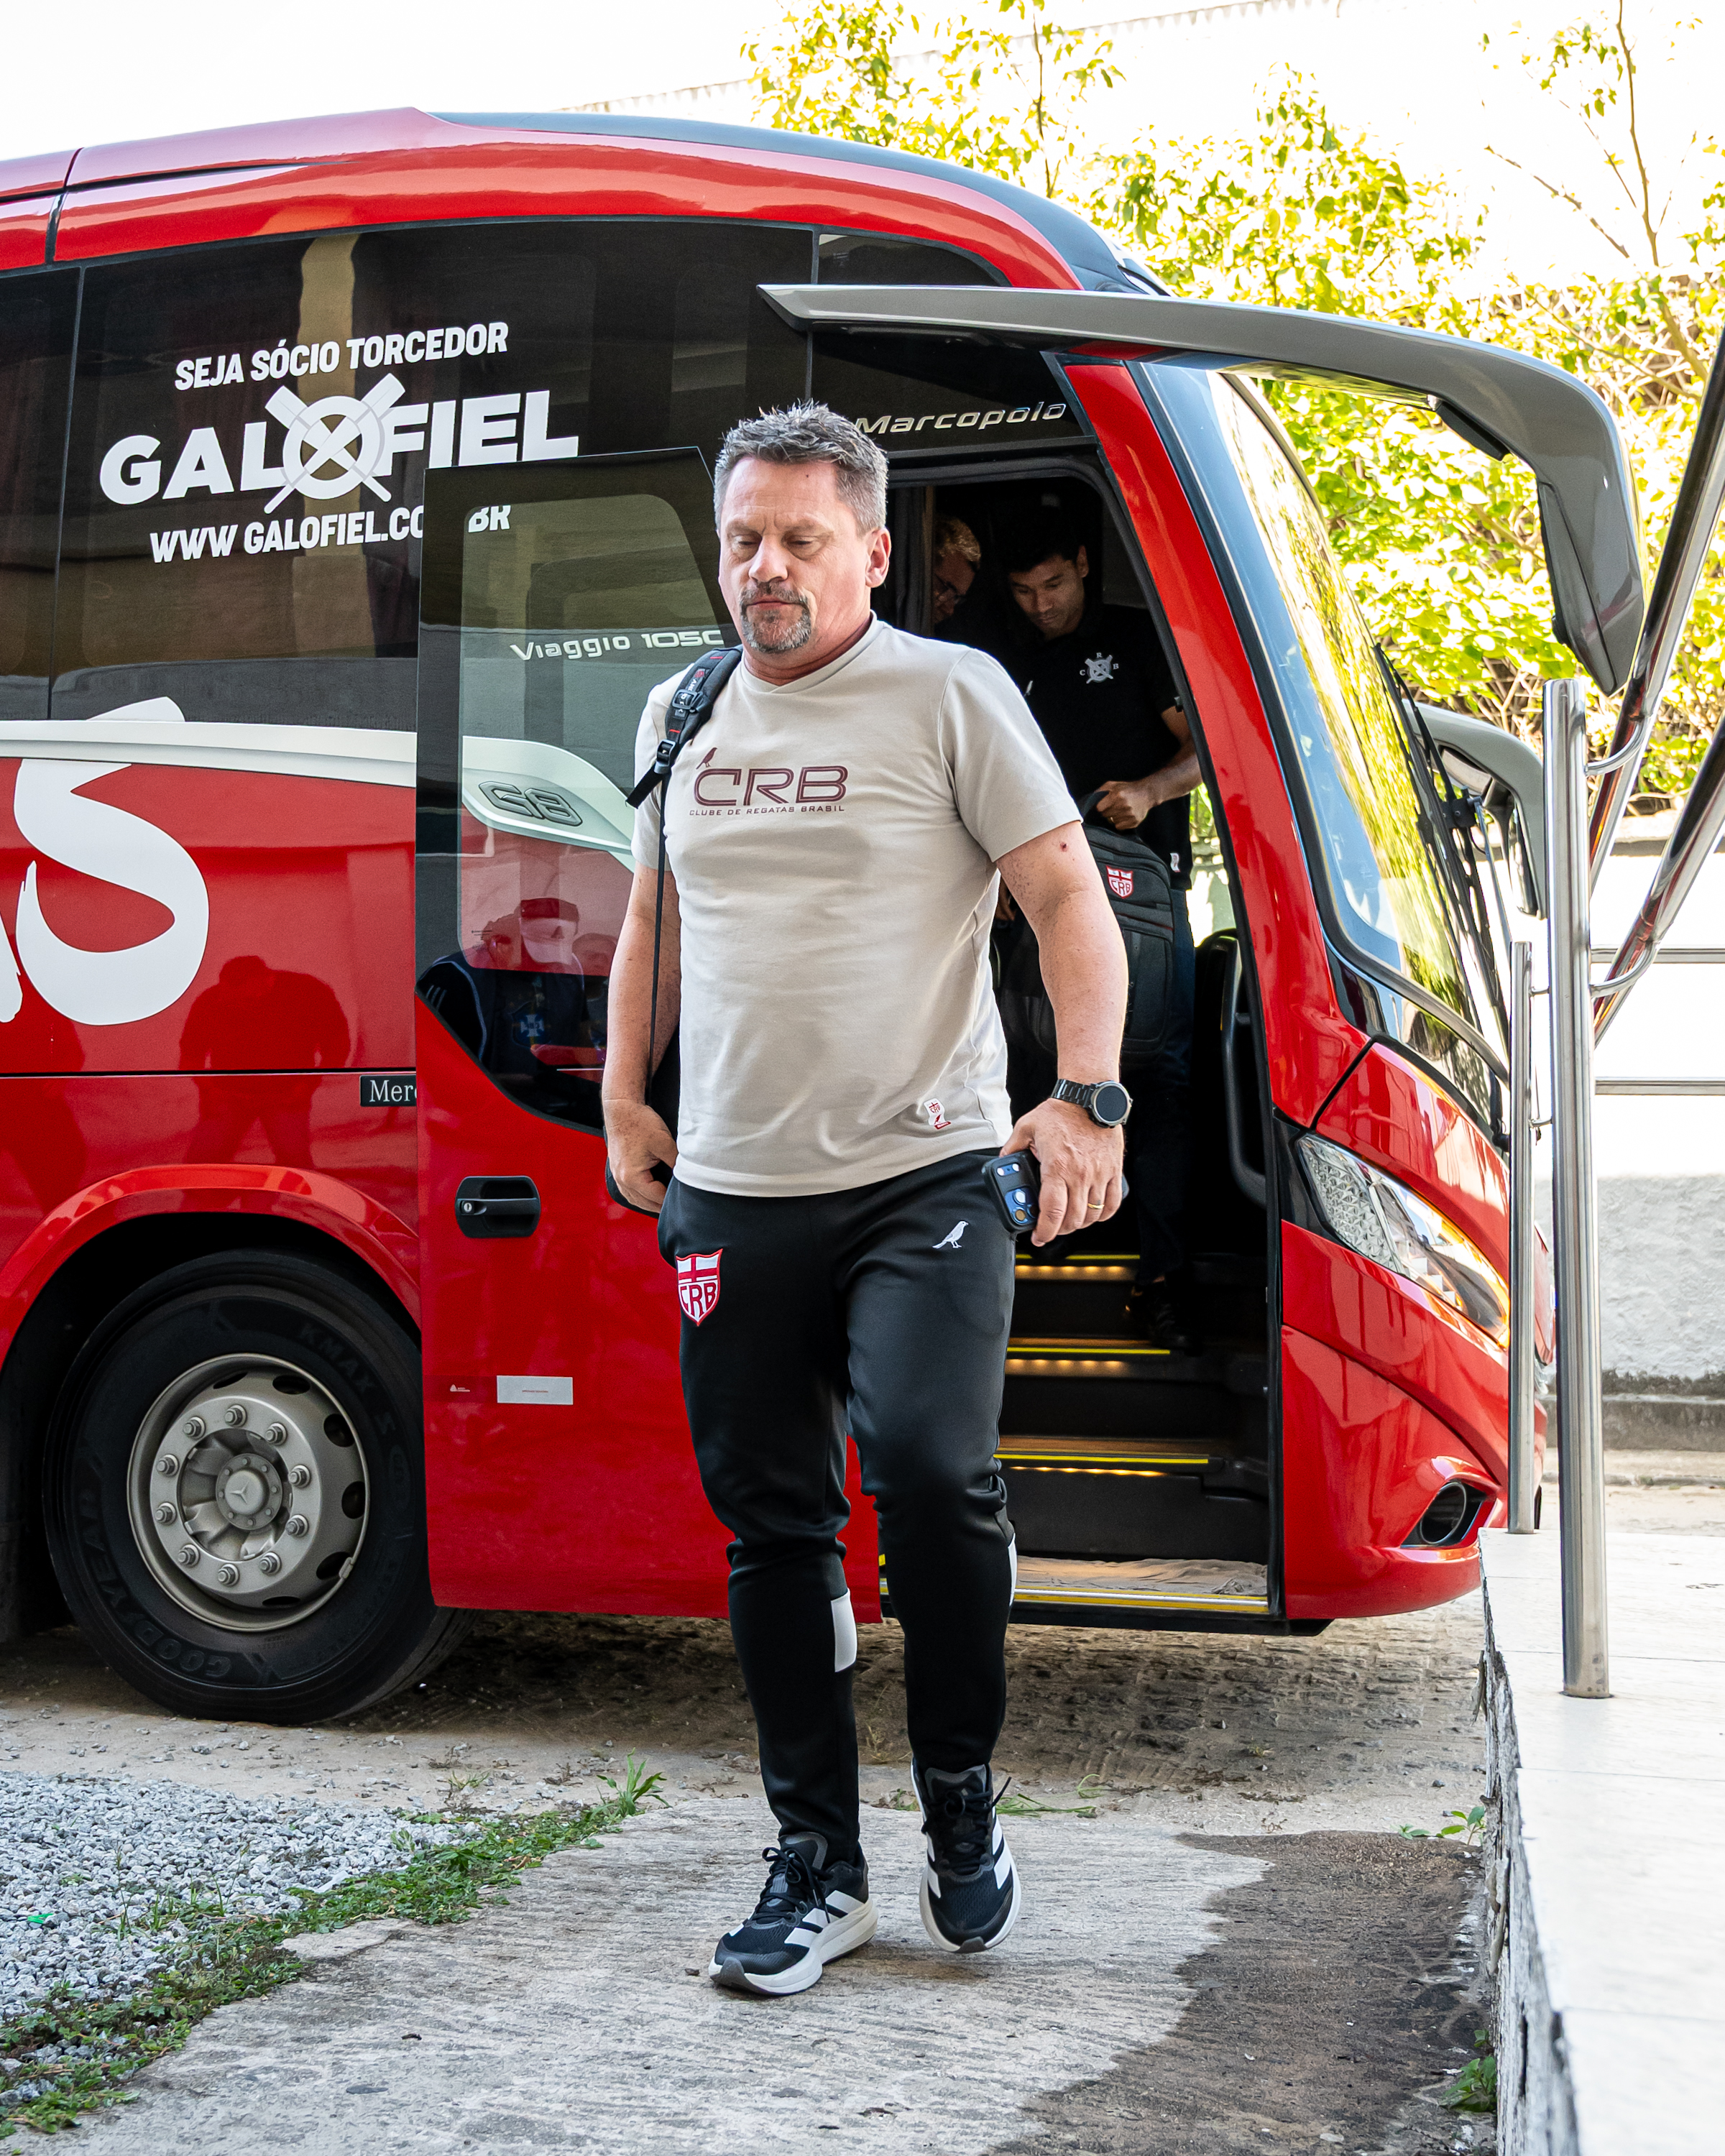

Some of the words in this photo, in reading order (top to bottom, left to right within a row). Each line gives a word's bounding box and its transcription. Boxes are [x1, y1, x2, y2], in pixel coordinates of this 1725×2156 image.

[175, 353, 244, 391] SEJA
[250, 338, 340, 381] SÓCIO
[345, 322, 509, 369] TORCEDOR
[855, 401, 1067, 434] Marcopolo
[99, 373, 579, 513] GALOFIEL
[150, 517, 239, 563] WWW
[510, 636, 630, 660] Viaggio
[694, 765, 848, 806] CRB
[1110, 880, 1131, 895] CRB
[369, 1079, 417, 1102] Mer
[679, 1282, 717, 1318] CRB
[79, 1489, 232, 1678] GOODYEAR
